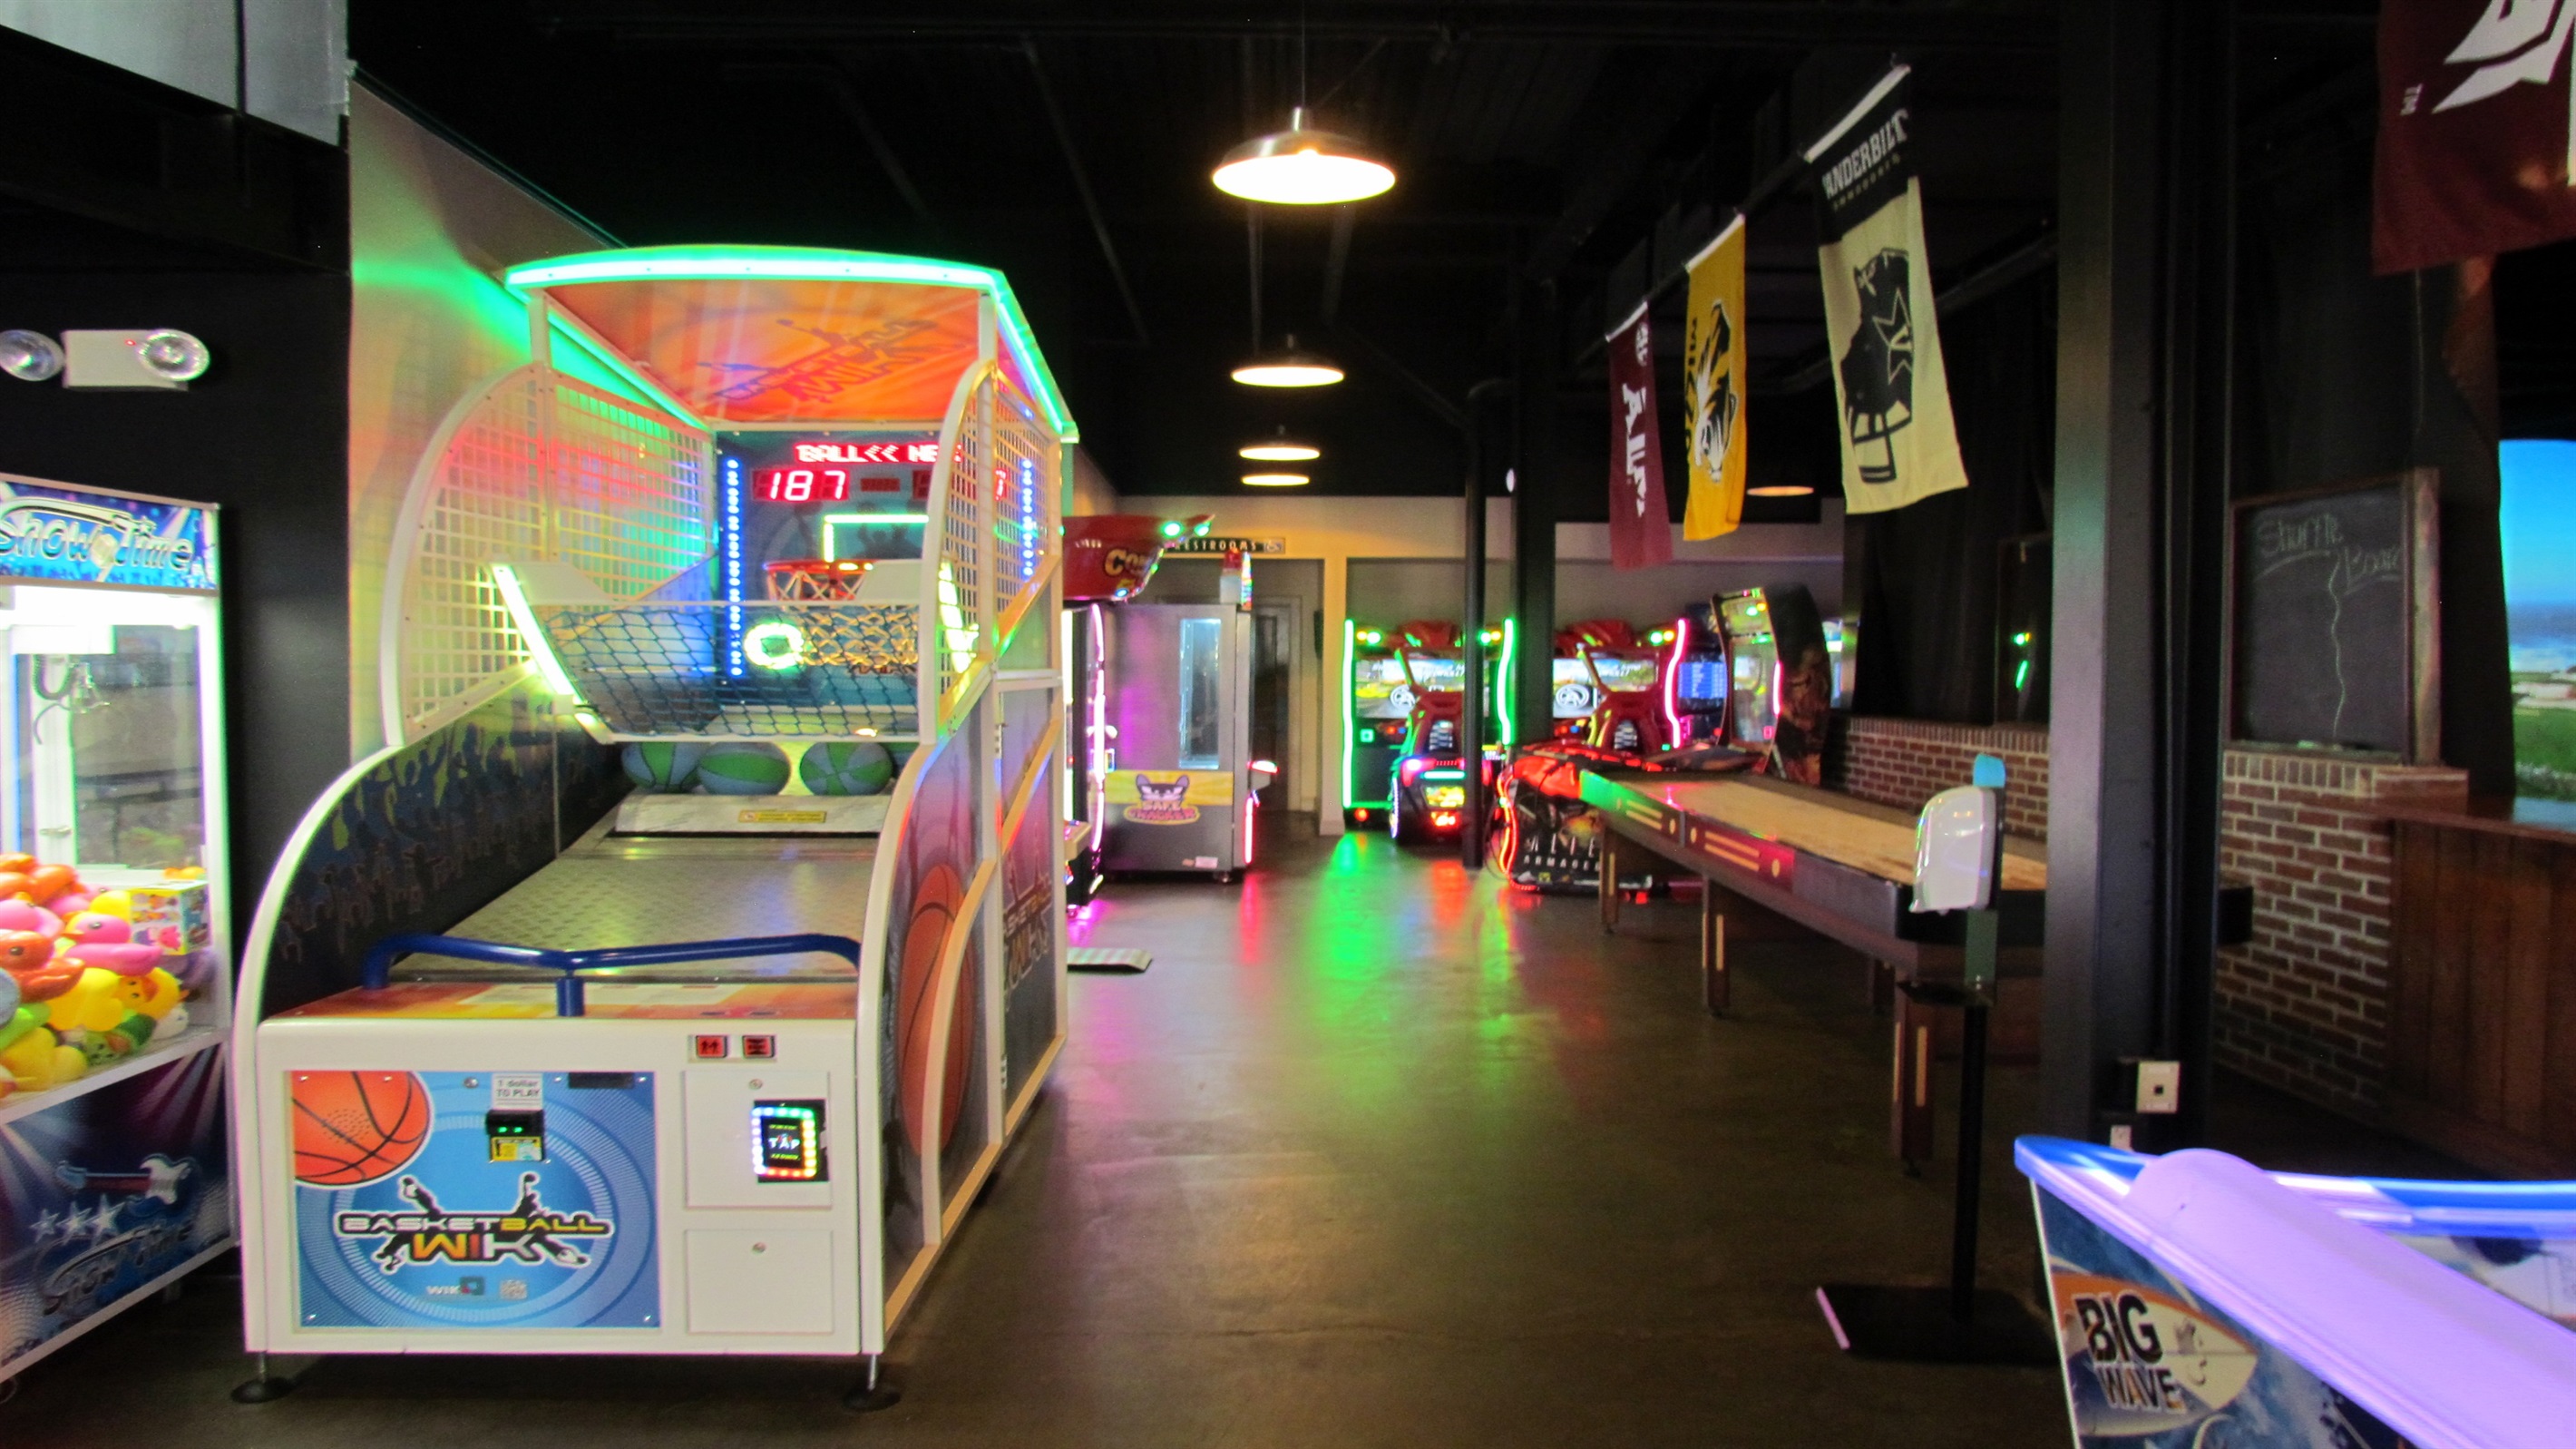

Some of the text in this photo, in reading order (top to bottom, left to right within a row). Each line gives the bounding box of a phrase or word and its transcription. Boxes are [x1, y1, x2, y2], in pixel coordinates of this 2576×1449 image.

[769, 470, 846, 501] 187
[496, 1089, 540, 1097] TO PLAY
[767, 1133, 801, 1150] TAP
[341, 1216, 607, 1232] BASKETBALL
[412, 1233, 537, 1260] WIK
[2074, 1292, 2164, 1365] BIG
[2094, 1365, 2185, 1411] WAVE
